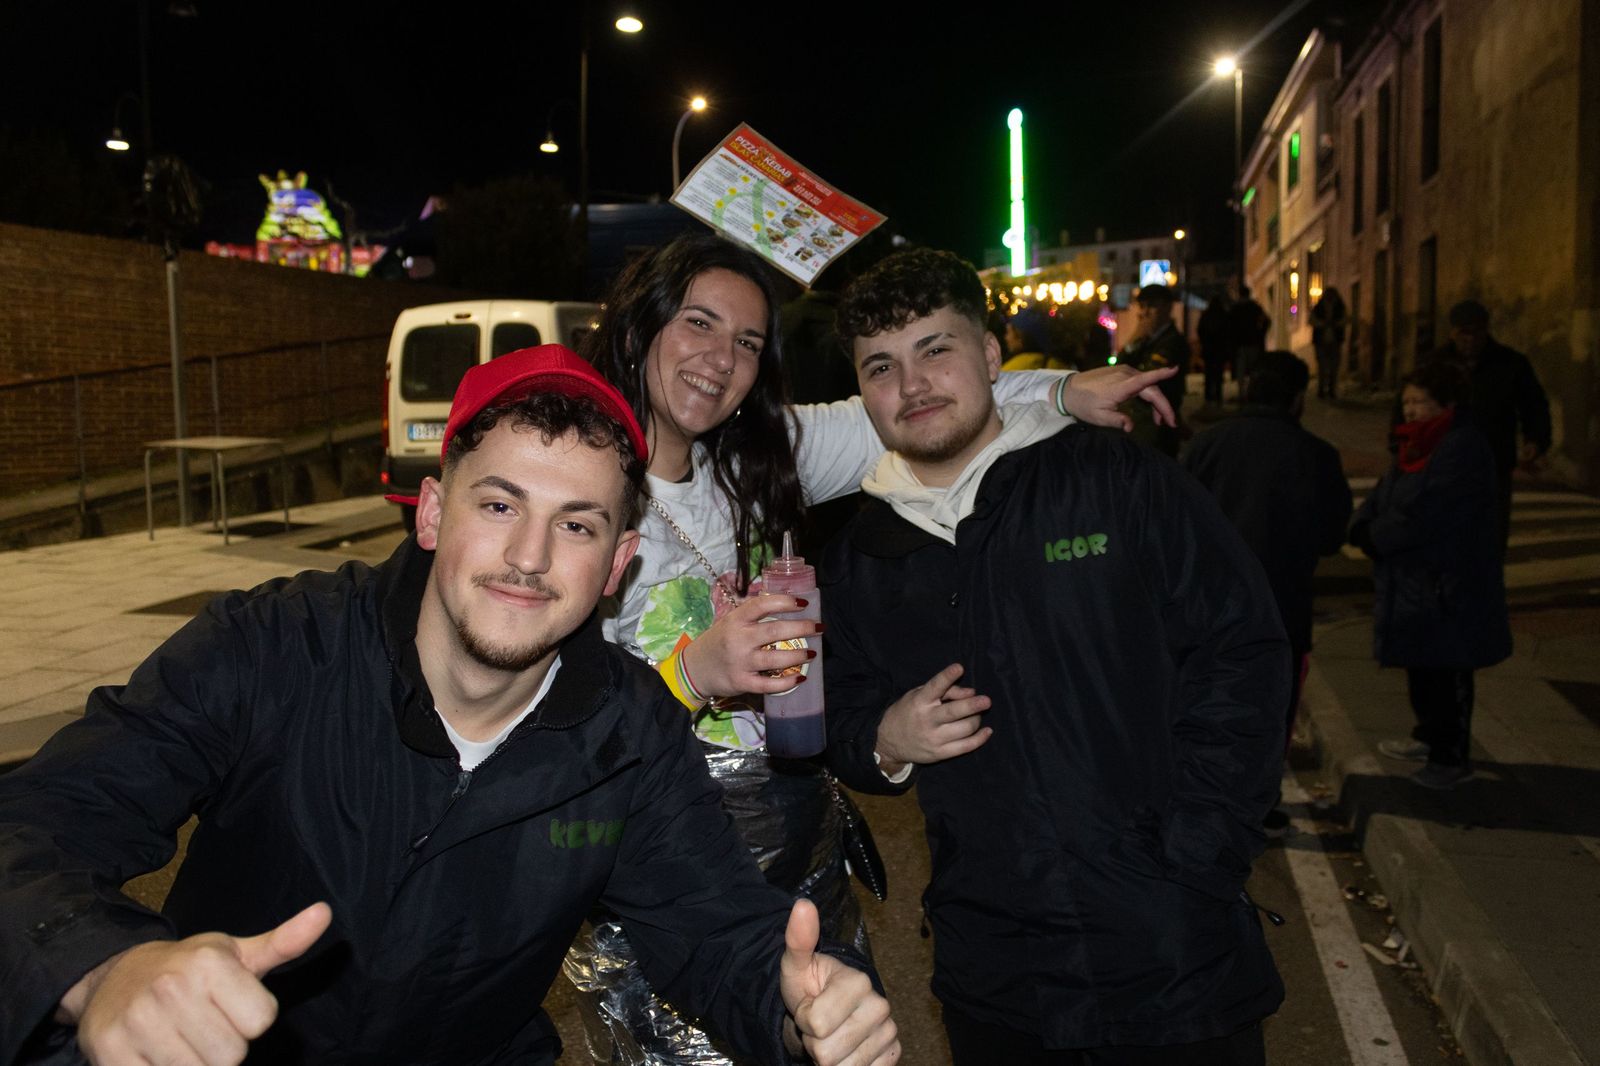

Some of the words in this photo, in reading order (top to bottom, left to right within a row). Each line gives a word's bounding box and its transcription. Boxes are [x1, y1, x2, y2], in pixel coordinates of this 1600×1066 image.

[735, 136, 760, 156] PIZZA
[763, 156, 792, 178] KEBAB
[1045, 533, 1108, 562] IGOR
